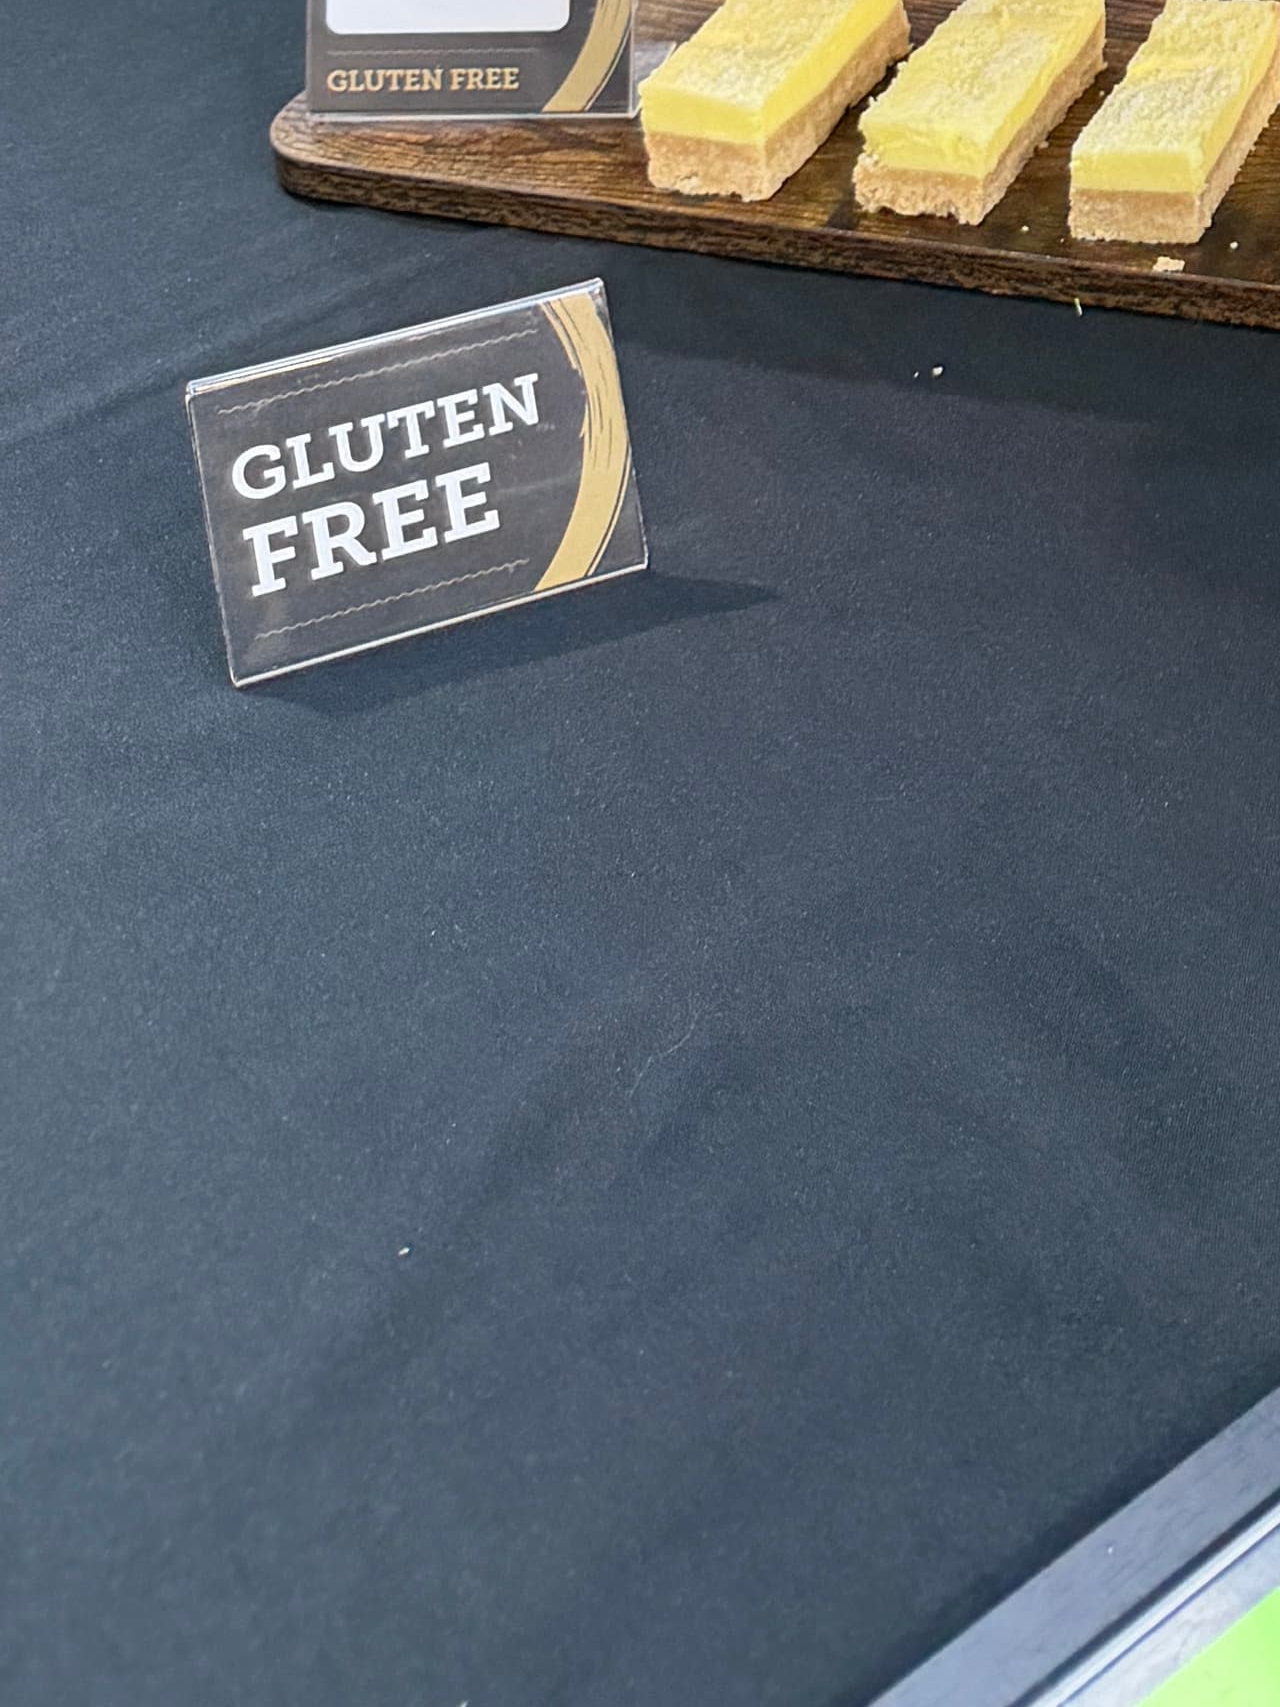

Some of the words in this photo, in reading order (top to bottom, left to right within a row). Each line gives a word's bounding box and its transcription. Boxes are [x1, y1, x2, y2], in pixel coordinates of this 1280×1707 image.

[326, 67, 443, 92] GLUTEN
[450, 67, 520, 90] FREE
[231, 372, 539, 500] GLUTEN
[242, 462, 500, 597] FREE
